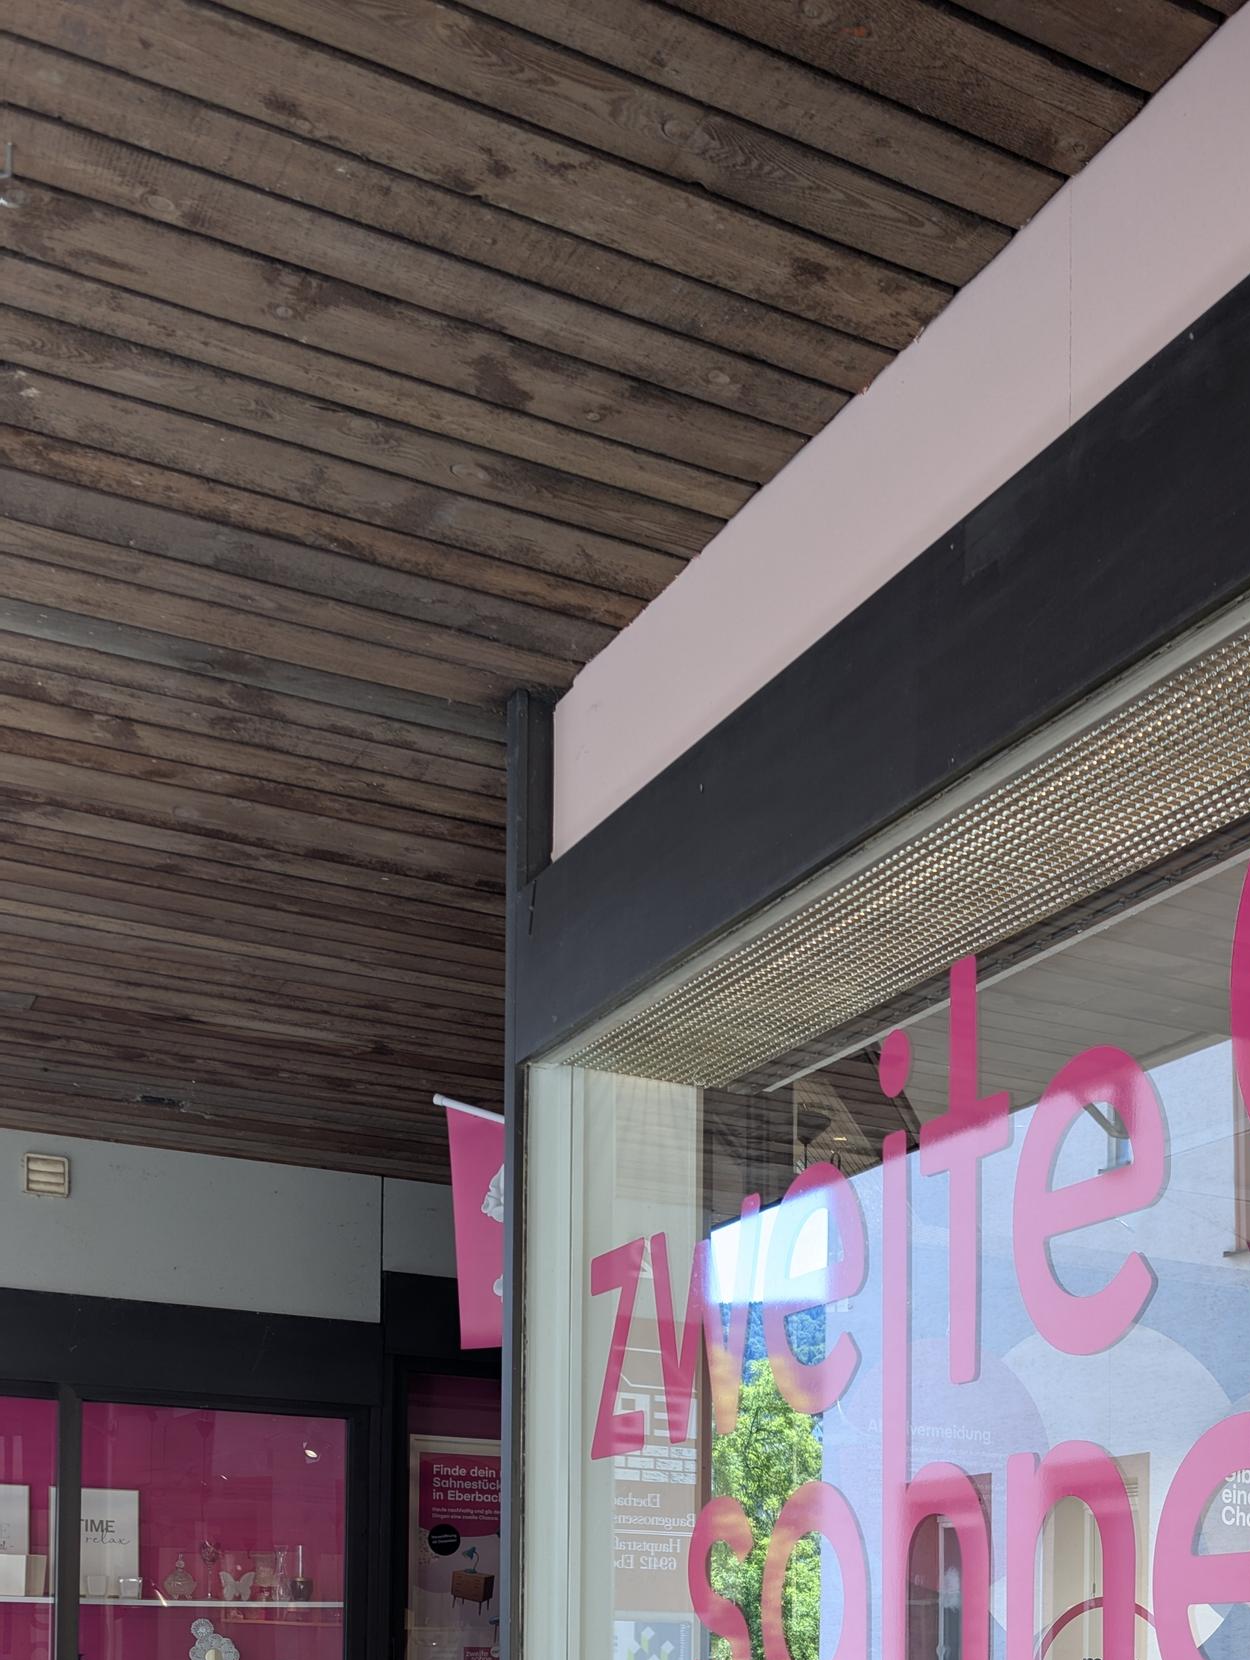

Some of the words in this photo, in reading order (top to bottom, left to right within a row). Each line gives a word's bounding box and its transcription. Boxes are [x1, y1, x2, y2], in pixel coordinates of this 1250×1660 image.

[590, 955, 1167, 1460] zweite
[868, 1419, 991, 1445] Avermeidung
[433, 1464, 467, 1476] Finde
[470, 1466, 496, 1478] dein
[433, 1489, 443, 1500] in
[85, 1528, 130, 1545] relax
